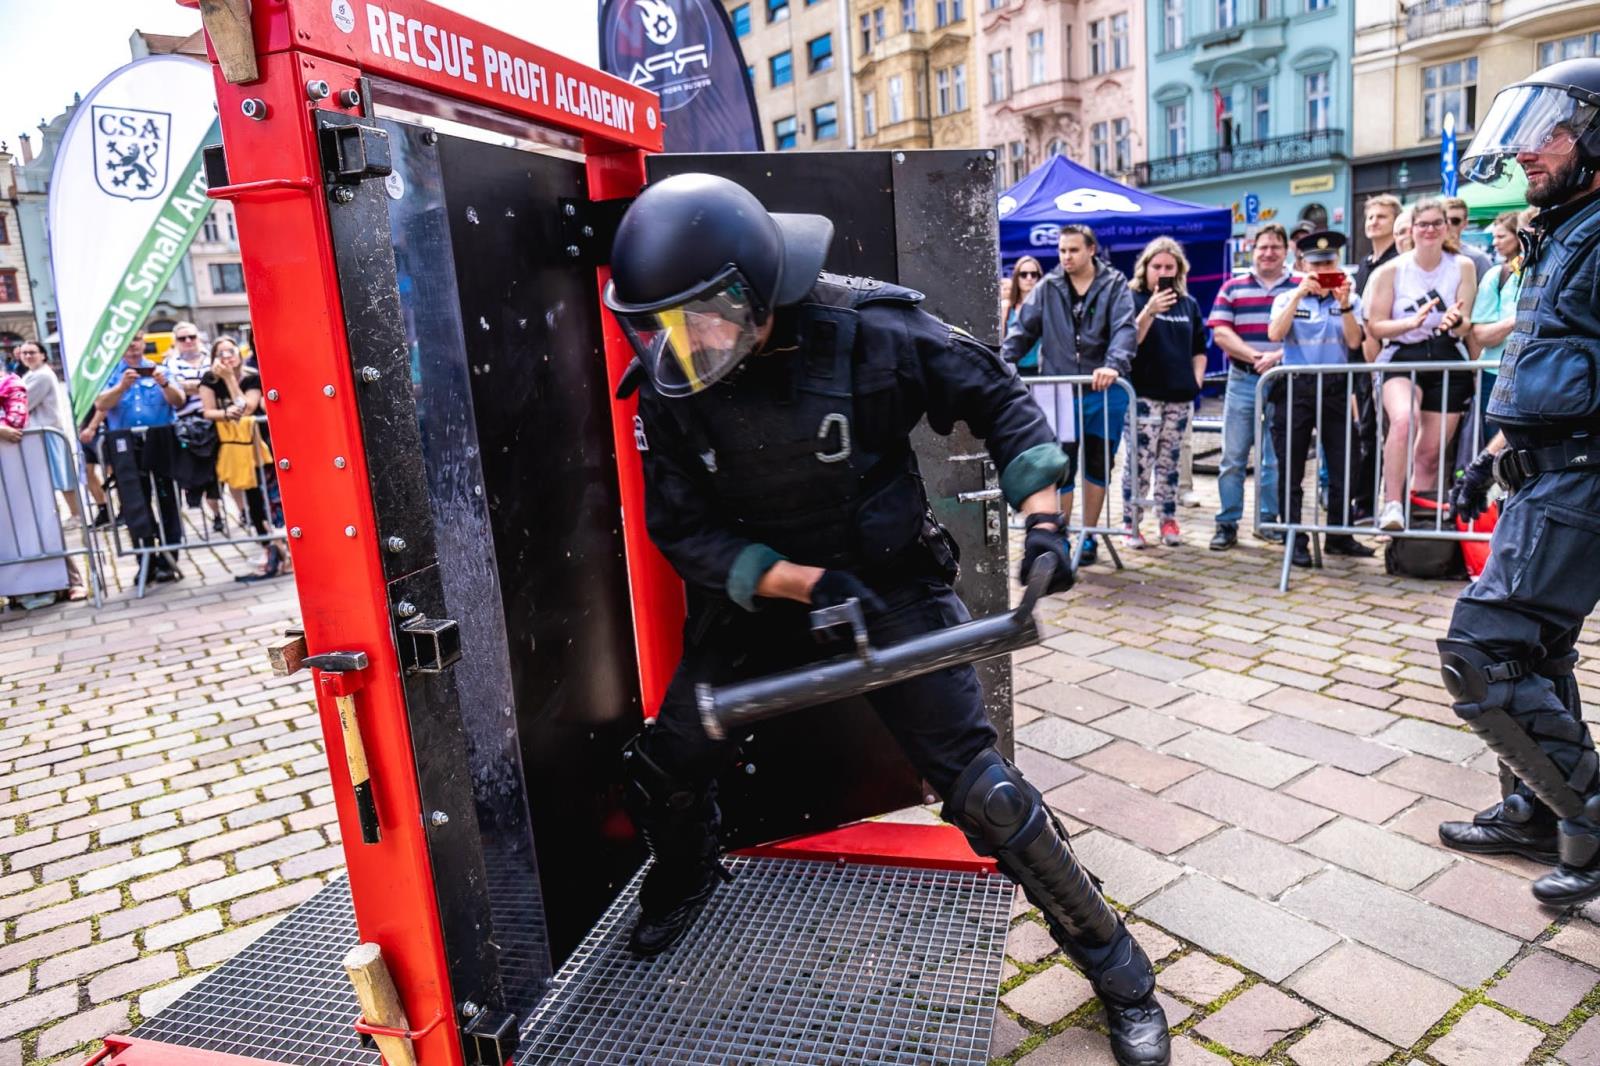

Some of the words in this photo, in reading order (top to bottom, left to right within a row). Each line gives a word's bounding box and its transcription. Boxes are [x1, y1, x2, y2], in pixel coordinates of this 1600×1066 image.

[98, 114, 161, 141] CSA
[365, 3, 477, 83] RECSUE
[482, 45, 549, 105] PROFI
[555, 72, 635, 133] ACADEMY
[81, 299, 142, 382] Czech
[125, 216, 187, 299] Small
